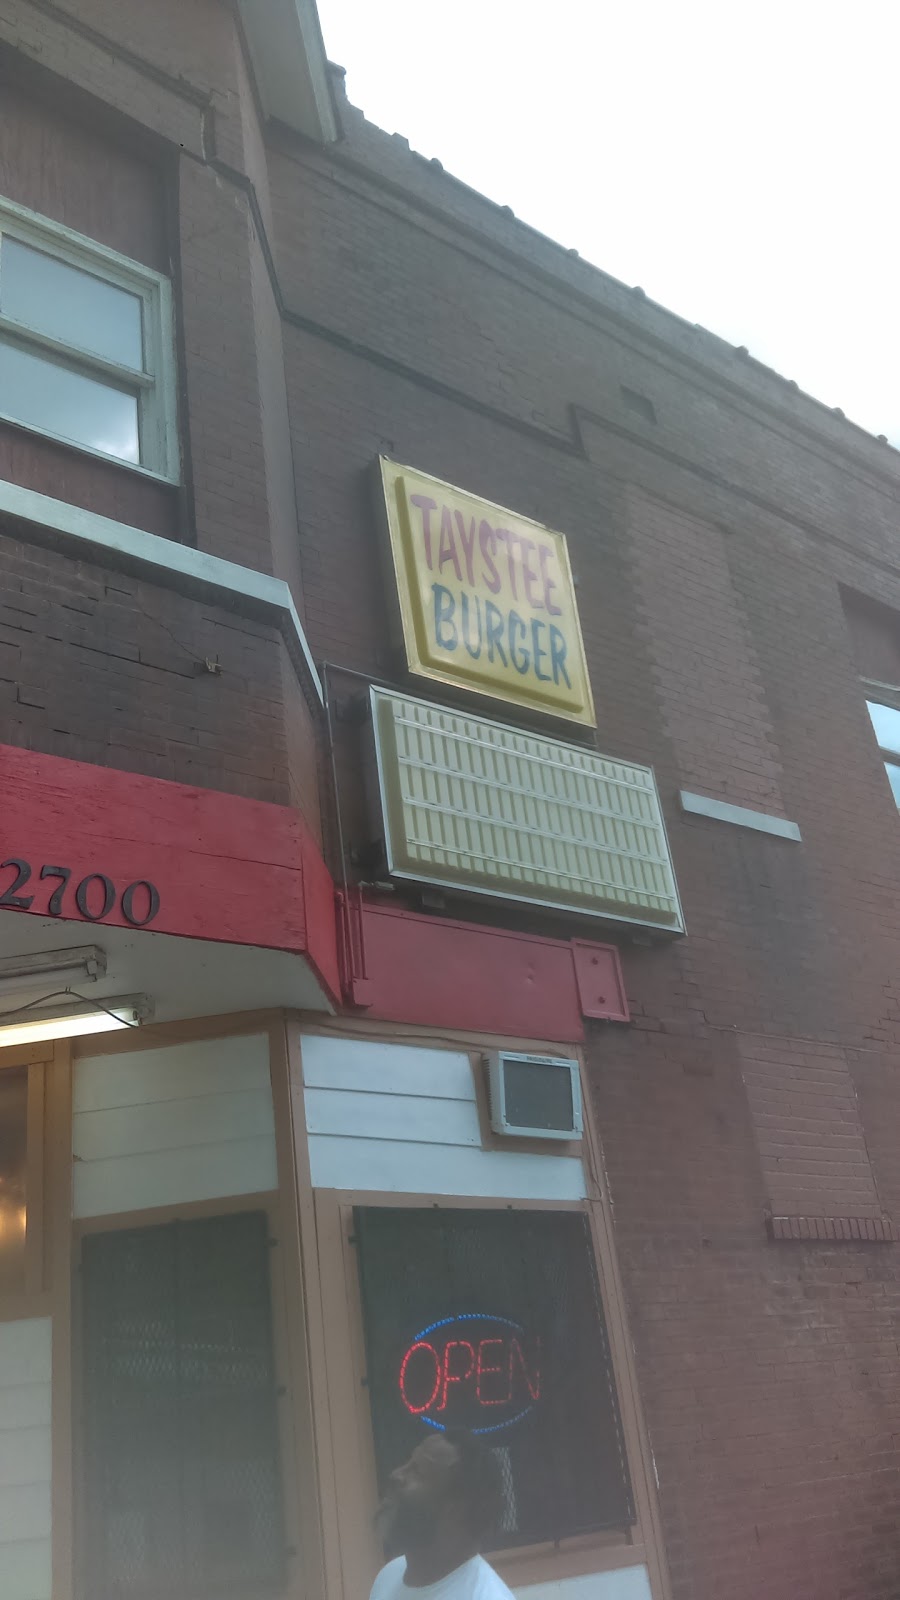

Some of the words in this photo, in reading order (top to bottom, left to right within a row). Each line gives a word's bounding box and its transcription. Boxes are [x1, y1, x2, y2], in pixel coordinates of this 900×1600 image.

[410, 494, 562, 616] TAYSTEE
[431, 582, 572, 689] BURGER
[0, 858, 161, 926] 2700
[400, 1337, 540, 1414] OPEN
